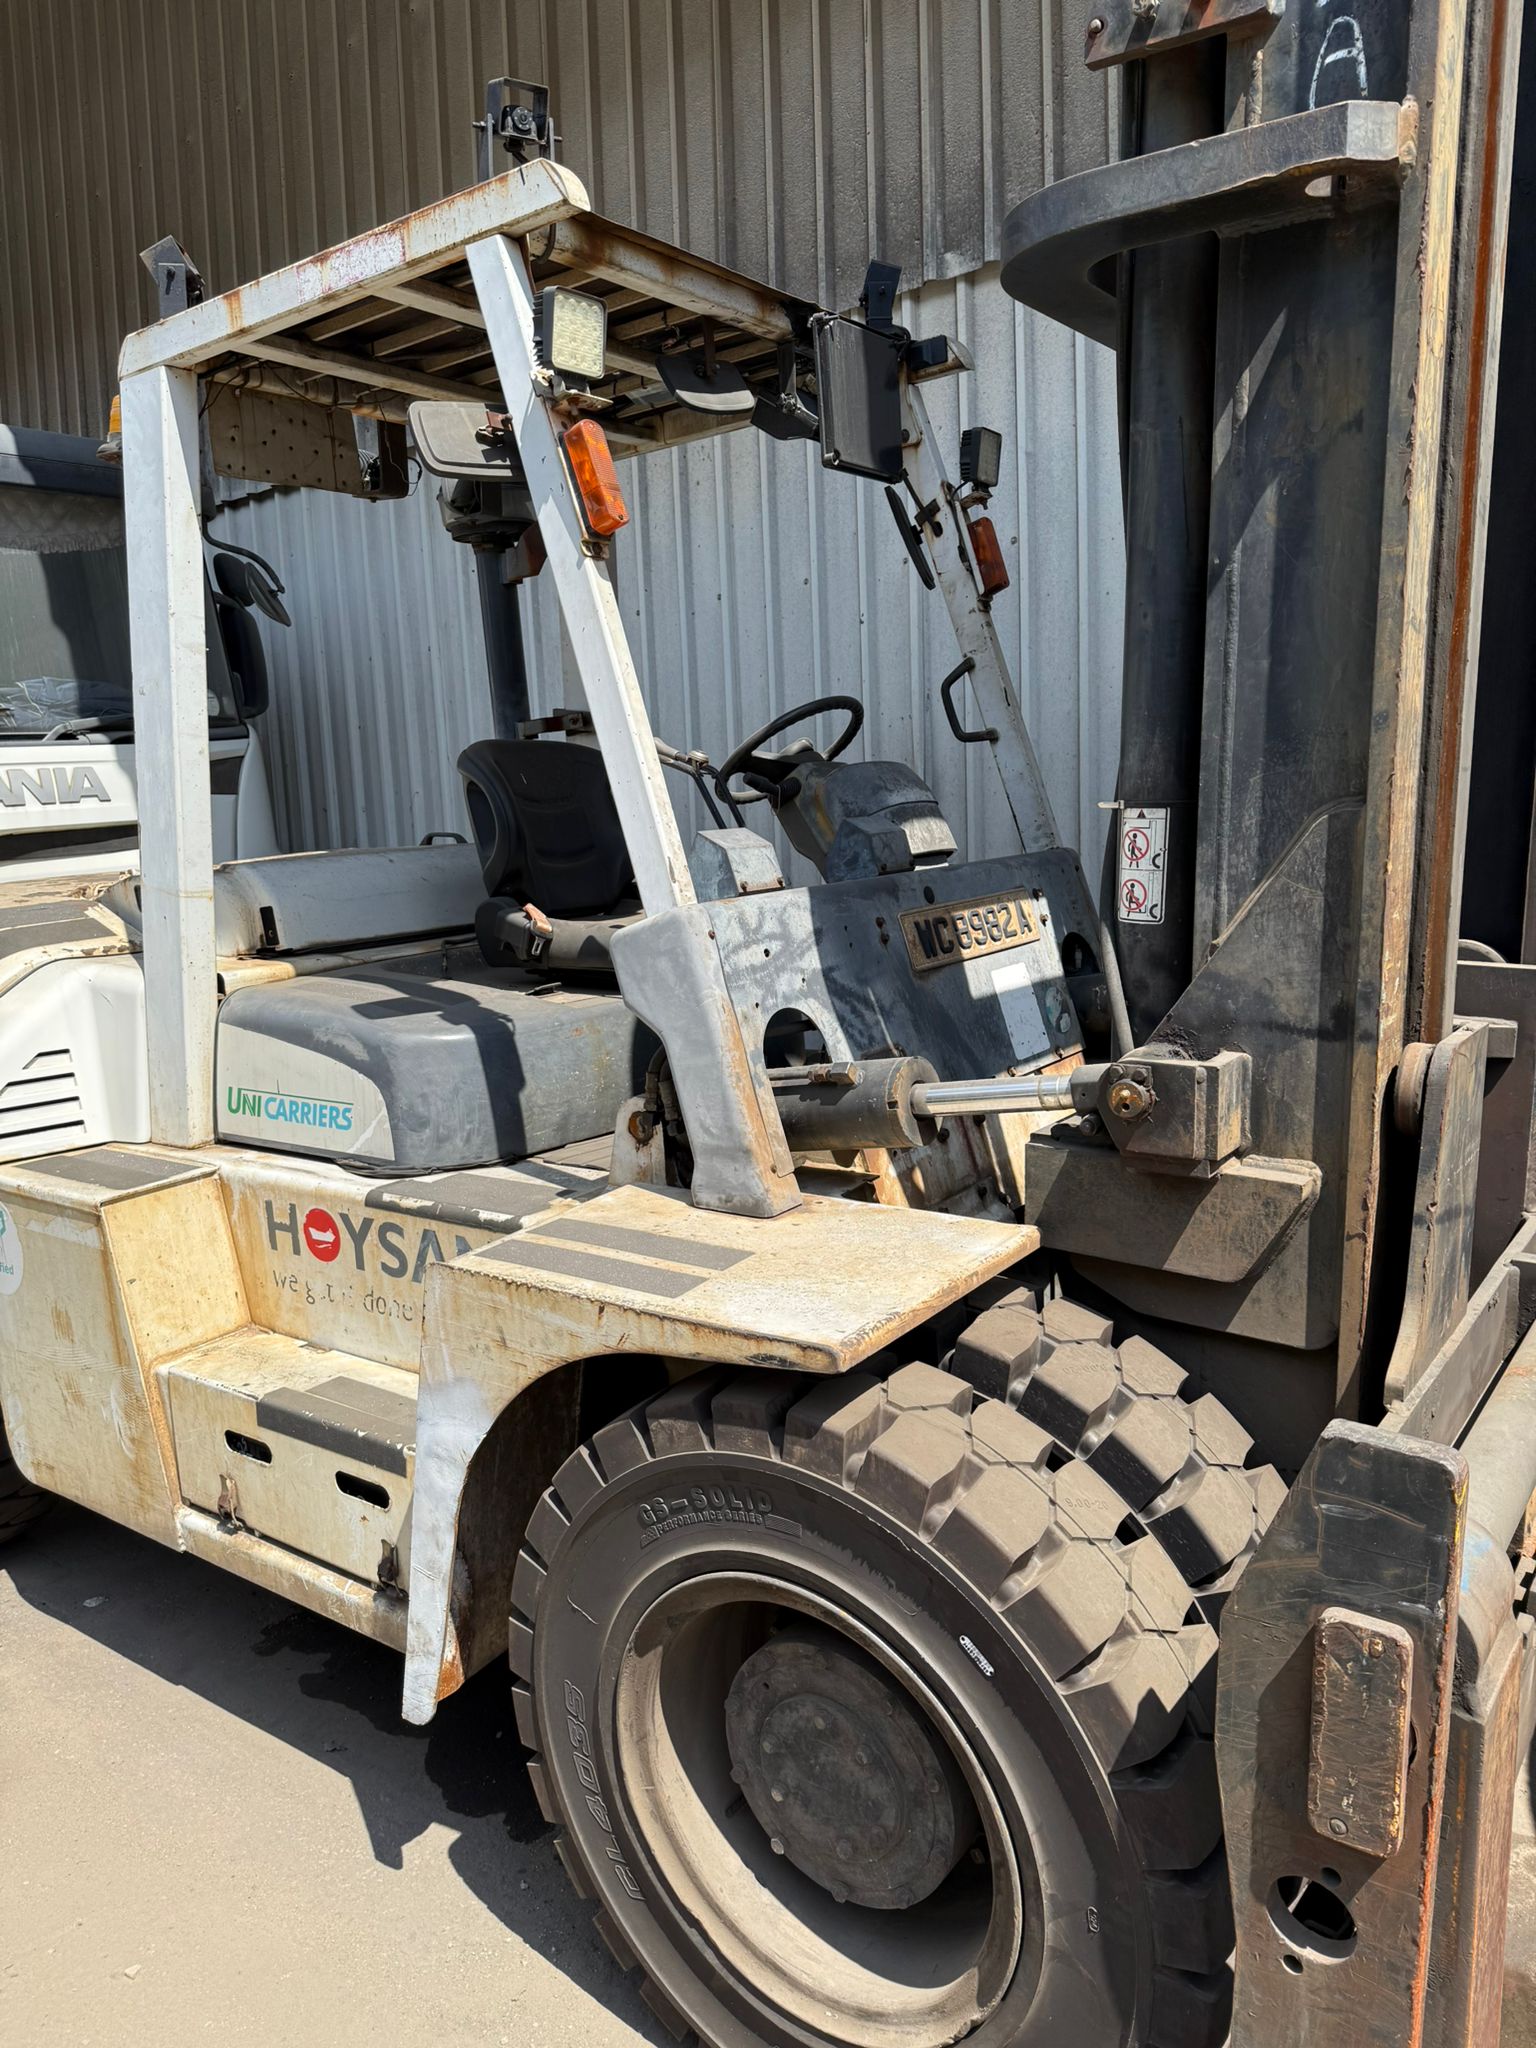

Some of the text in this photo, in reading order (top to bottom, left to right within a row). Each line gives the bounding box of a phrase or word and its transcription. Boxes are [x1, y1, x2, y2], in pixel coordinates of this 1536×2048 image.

[0, 766, 112, 808] NIA
[913, 899, 1033, 959] WC8982A
[227, 1086, 354, 1131] UNICARRIERS
[264, 1199, 474, 1284] HOYSA
[639, 1486, 773, 1525] GS-SOLID
[657, 1509, 763, 1536] PERFORMANCE SERIES
